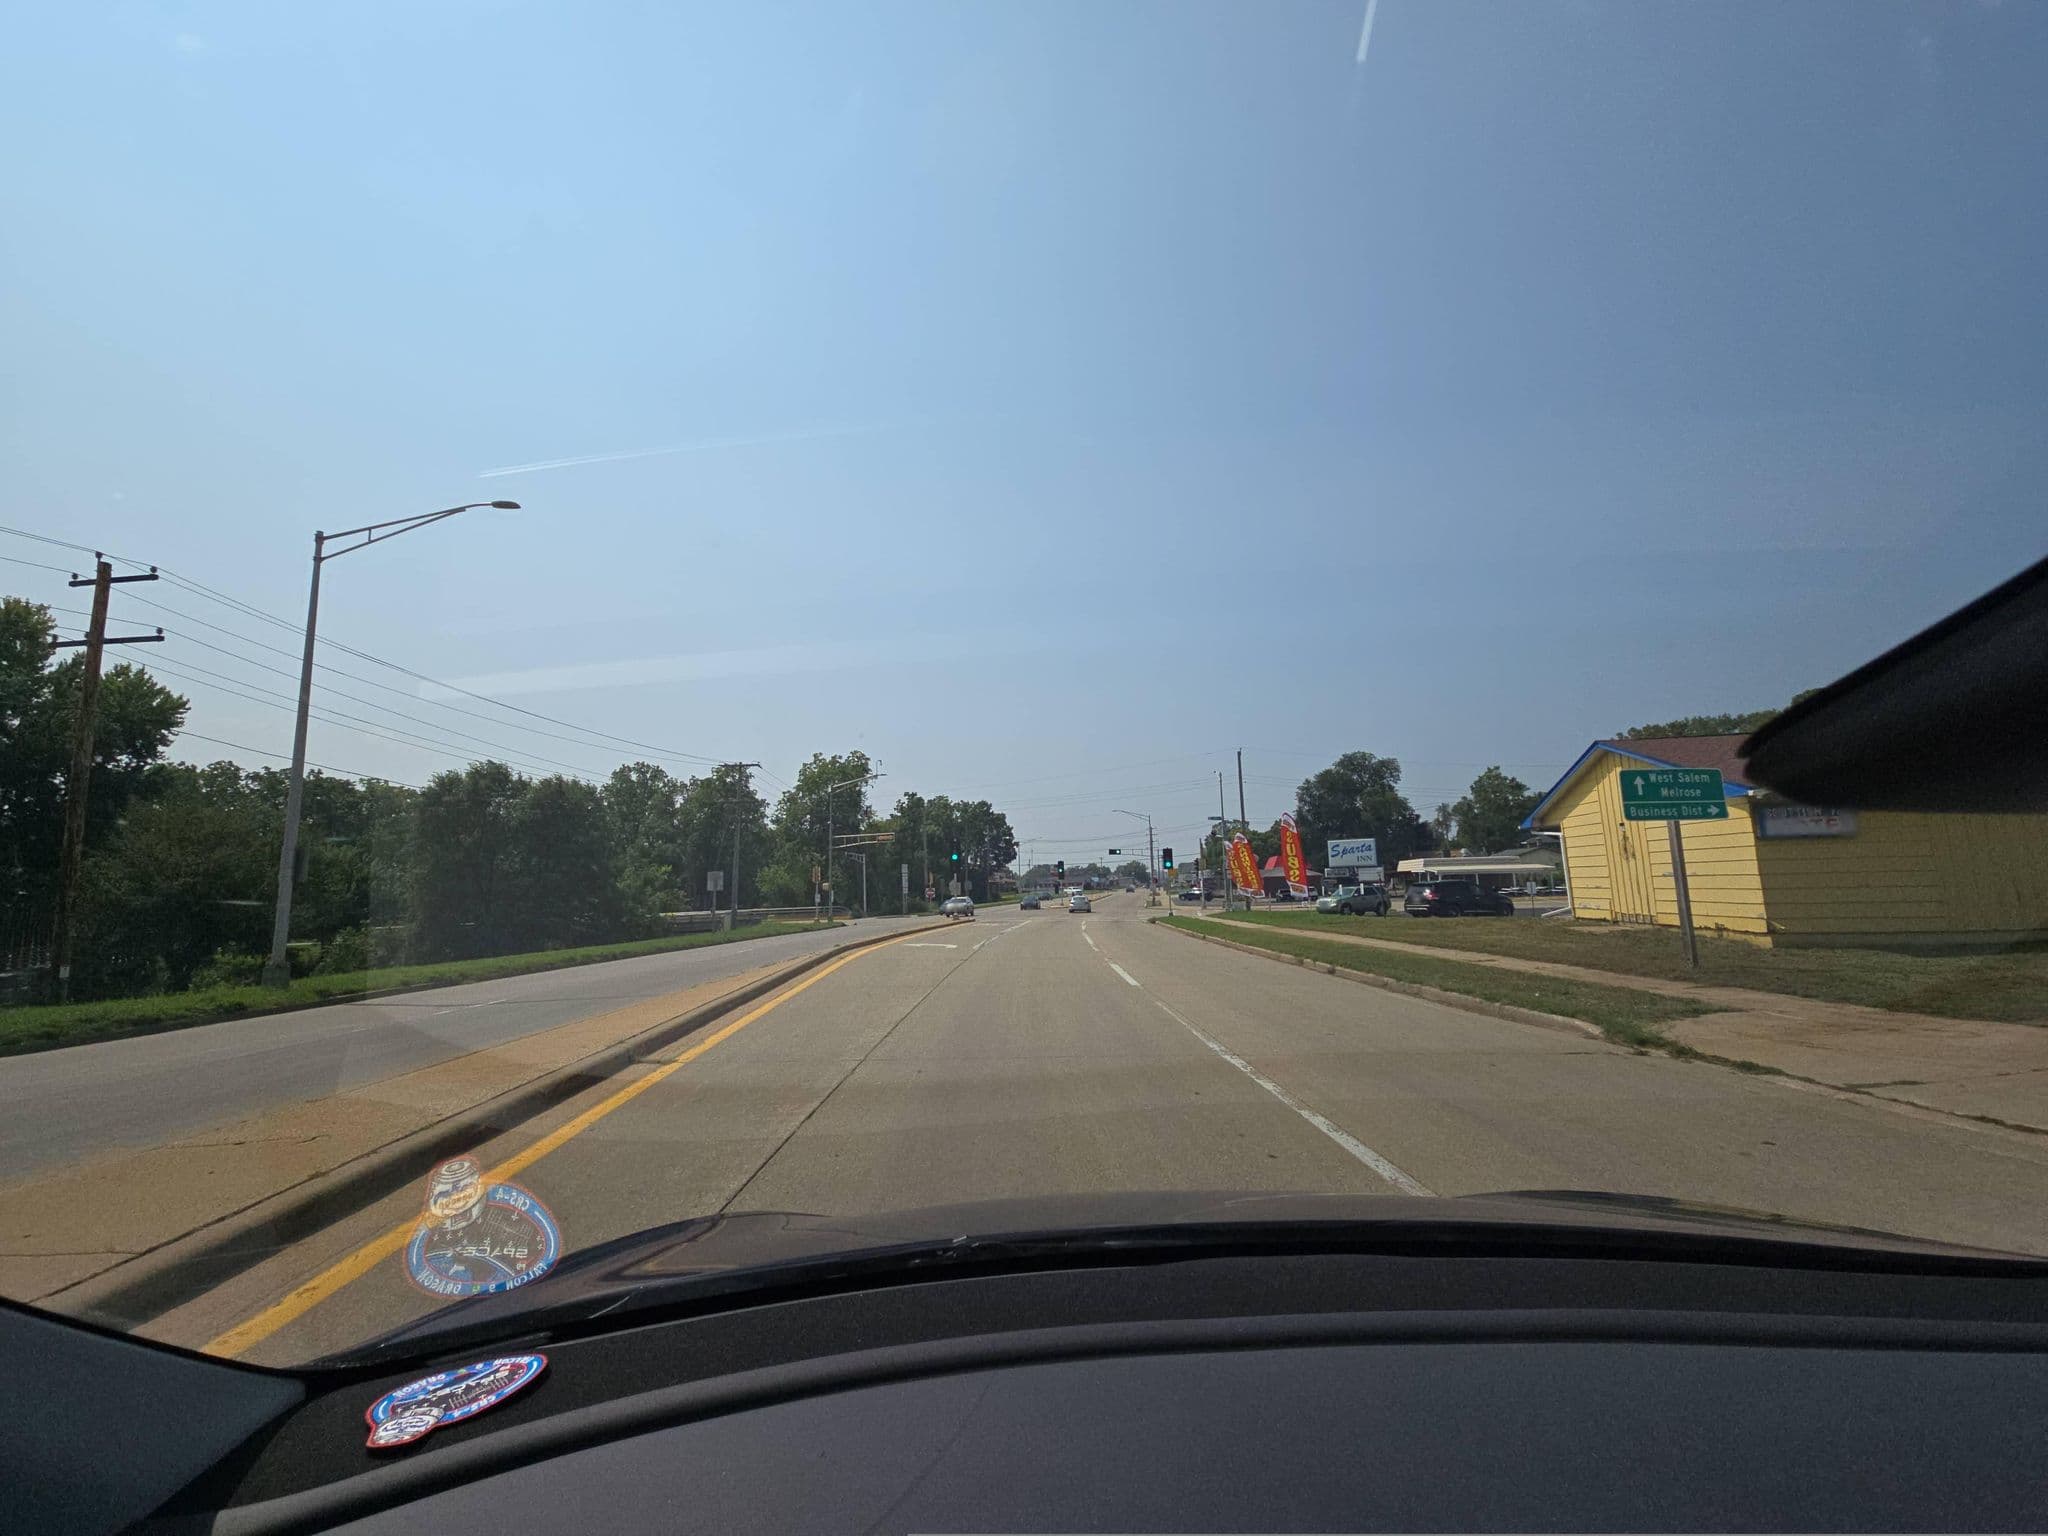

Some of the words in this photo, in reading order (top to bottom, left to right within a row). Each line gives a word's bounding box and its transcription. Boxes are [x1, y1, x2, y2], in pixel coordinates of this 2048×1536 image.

[1649, 773, 1674, 783] West
[1678, 772, 1710, 783] Salem
[1660, 787, 1701, 797] Melrose
[1630, 806, 1678, 817] Business
[1682, 806, 1703, 816] Dist
[1331, 843, 1373, 858] Sparta
[1357, 855, 1373, 863] INN
